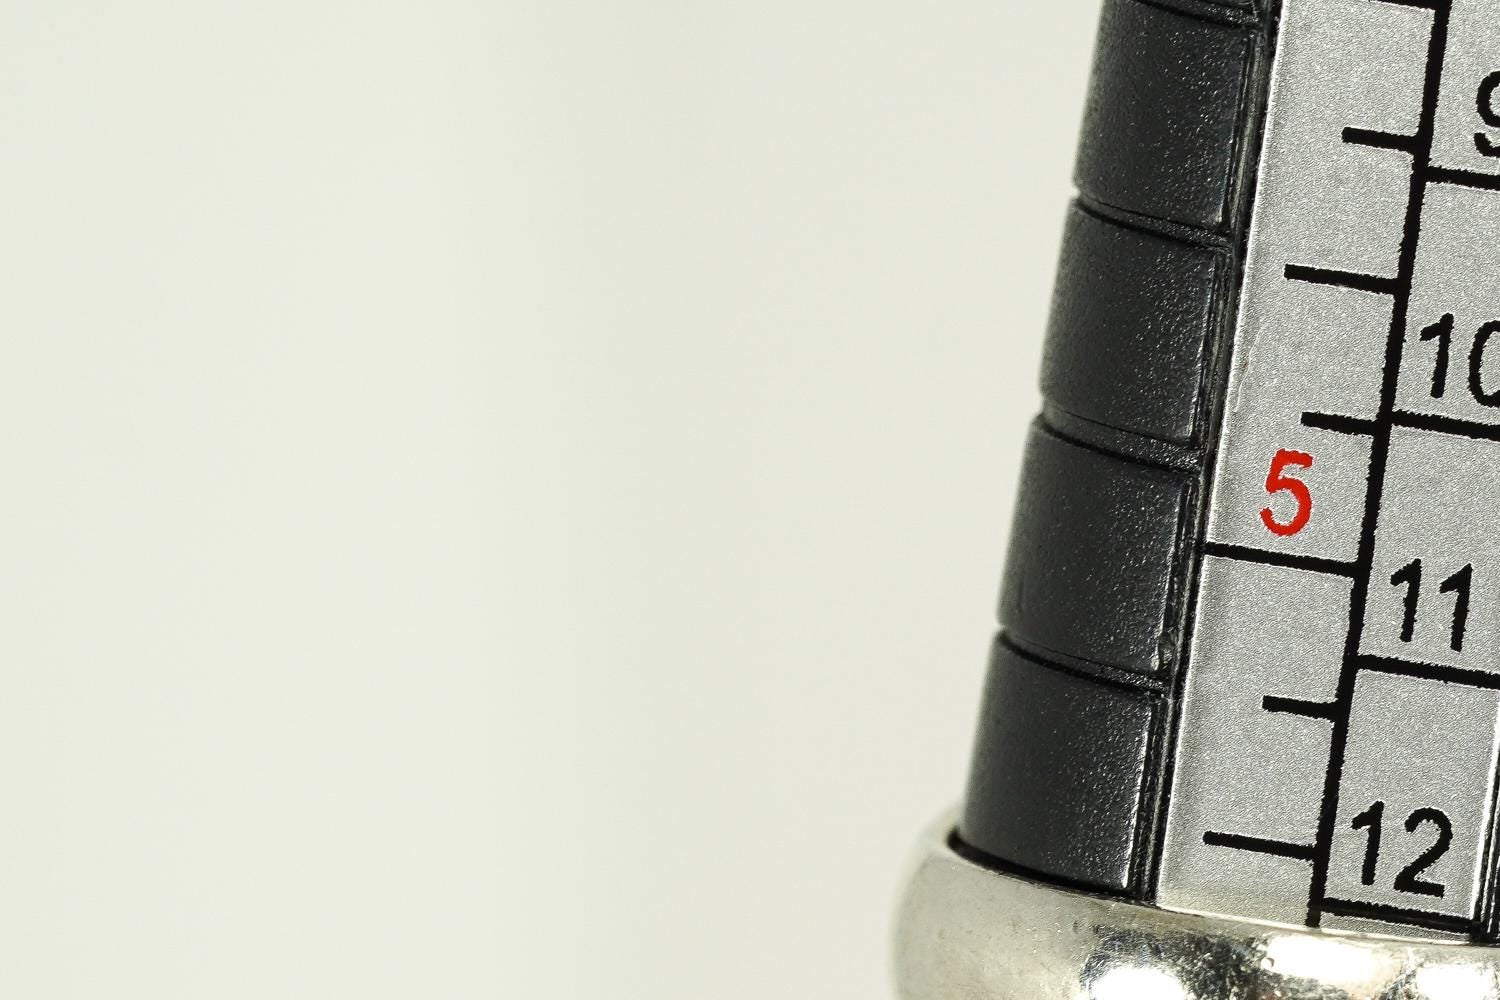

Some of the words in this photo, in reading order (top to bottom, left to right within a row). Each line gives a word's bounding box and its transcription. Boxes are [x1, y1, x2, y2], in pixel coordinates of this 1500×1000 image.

[1259, 448, 1314, 537] 5
[1390, 559, 1473, 652] 11
[1351, 801, 1453, 899] 12
